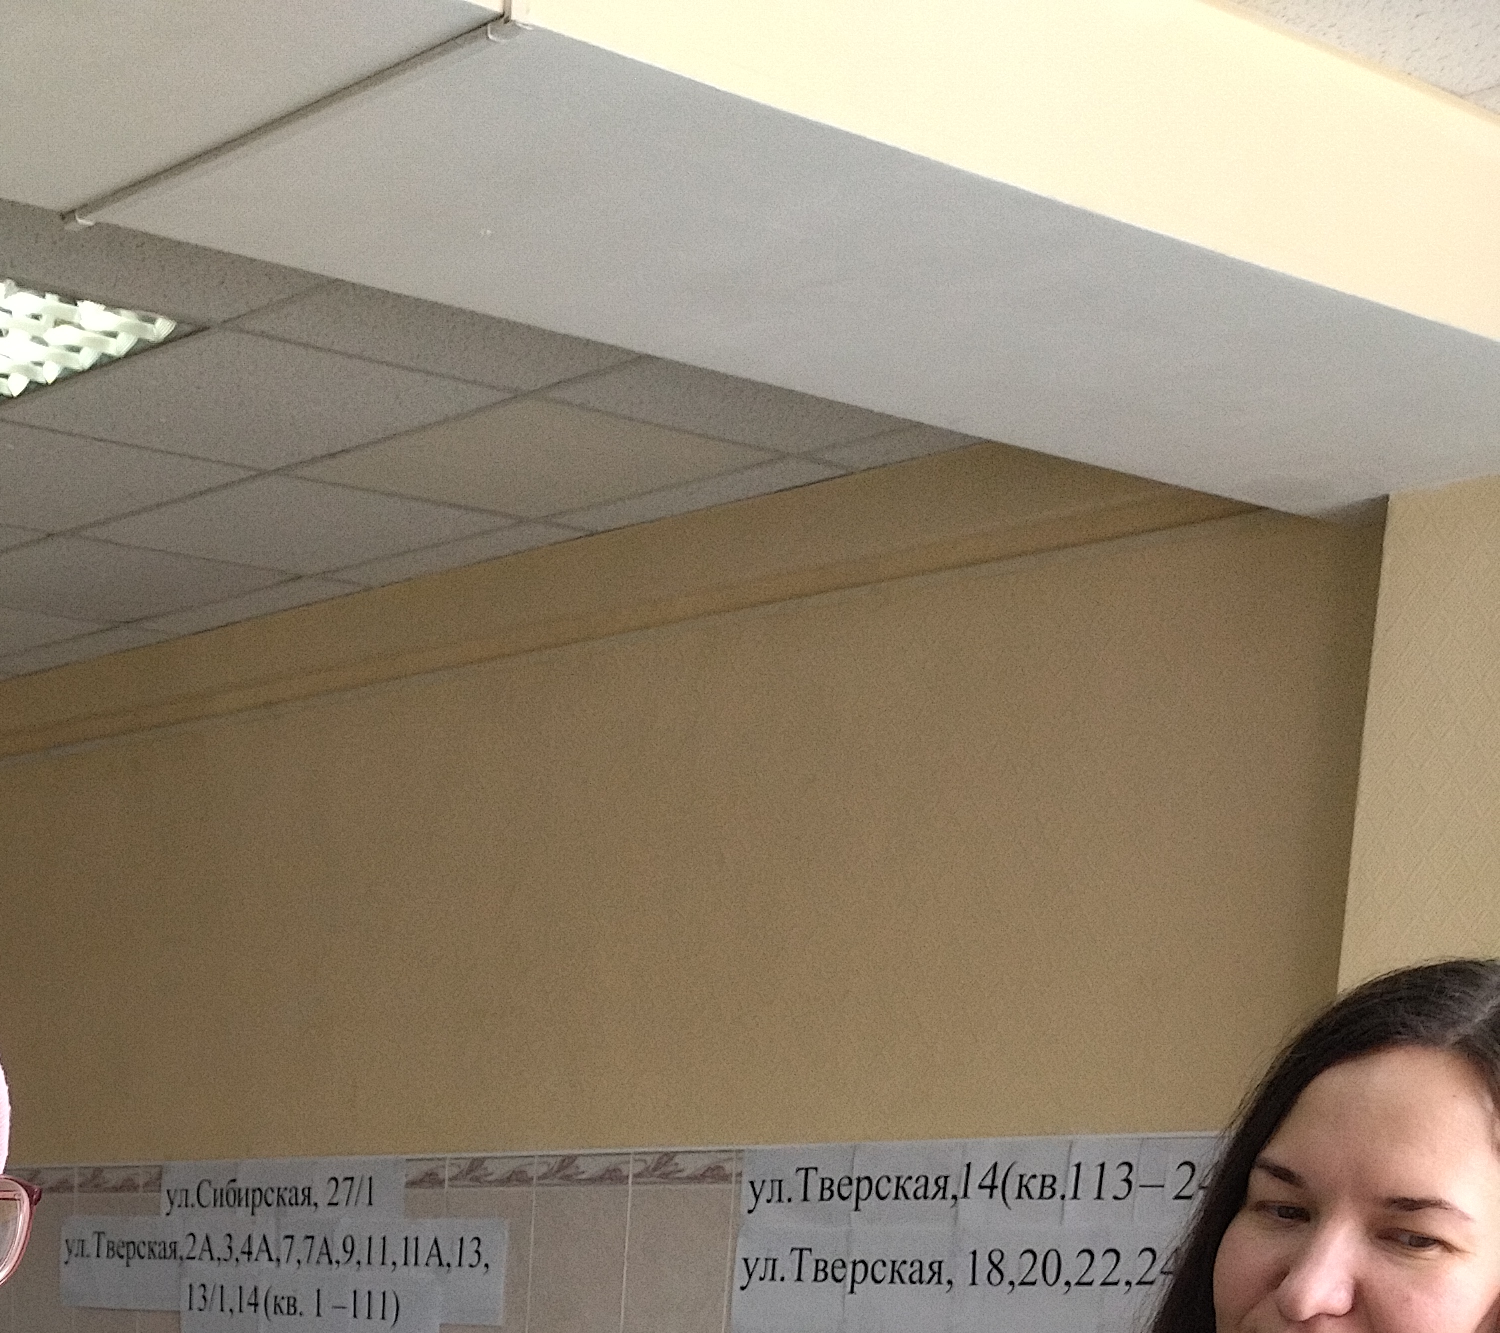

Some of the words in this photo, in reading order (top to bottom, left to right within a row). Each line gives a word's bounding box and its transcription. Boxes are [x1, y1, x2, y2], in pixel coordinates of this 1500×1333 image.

[165, 1178, 319, 1215] ул.Сибирская,
[327, 1175, 374, 1208] 27/1
[739, 1247, 954, 1295] ул.Тверская,
